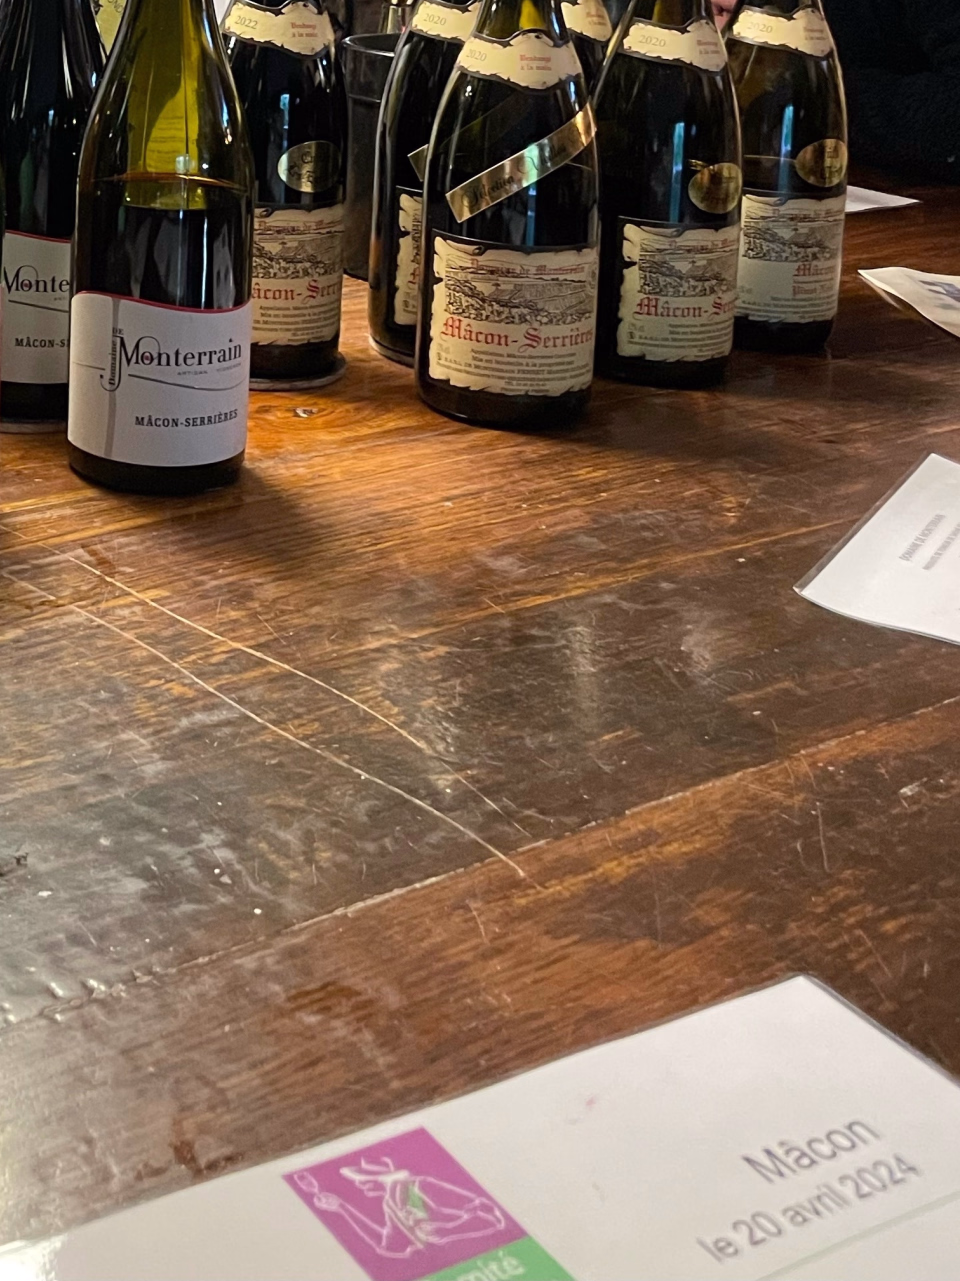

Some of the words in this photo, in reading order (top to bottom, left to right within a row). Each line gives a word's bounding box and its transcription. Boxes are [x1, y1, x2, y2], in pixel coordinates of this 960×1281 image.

[234, 15, 259, 30] 2022
[423, 12, 447, 27] 2020
[746, 20, 774, 34] 2020
[638, 34, 667, 48] 2020
[465, 48, 488, 62] 2020
[441, 316, 594, 353] Mâcon-Serrières
[119, 335, 242, 368] Monterrain
[134, 407, 239, 428] MÂCON-SERRIÈRES
[741, 1119, 883, 1185] Mâcon
[695, 1235, 740, 1263] le
[731, 1210, 783, 1247] 20
[780, 1182, 852, 1228] avril
[838, 1152, 922, 1200] 2024
